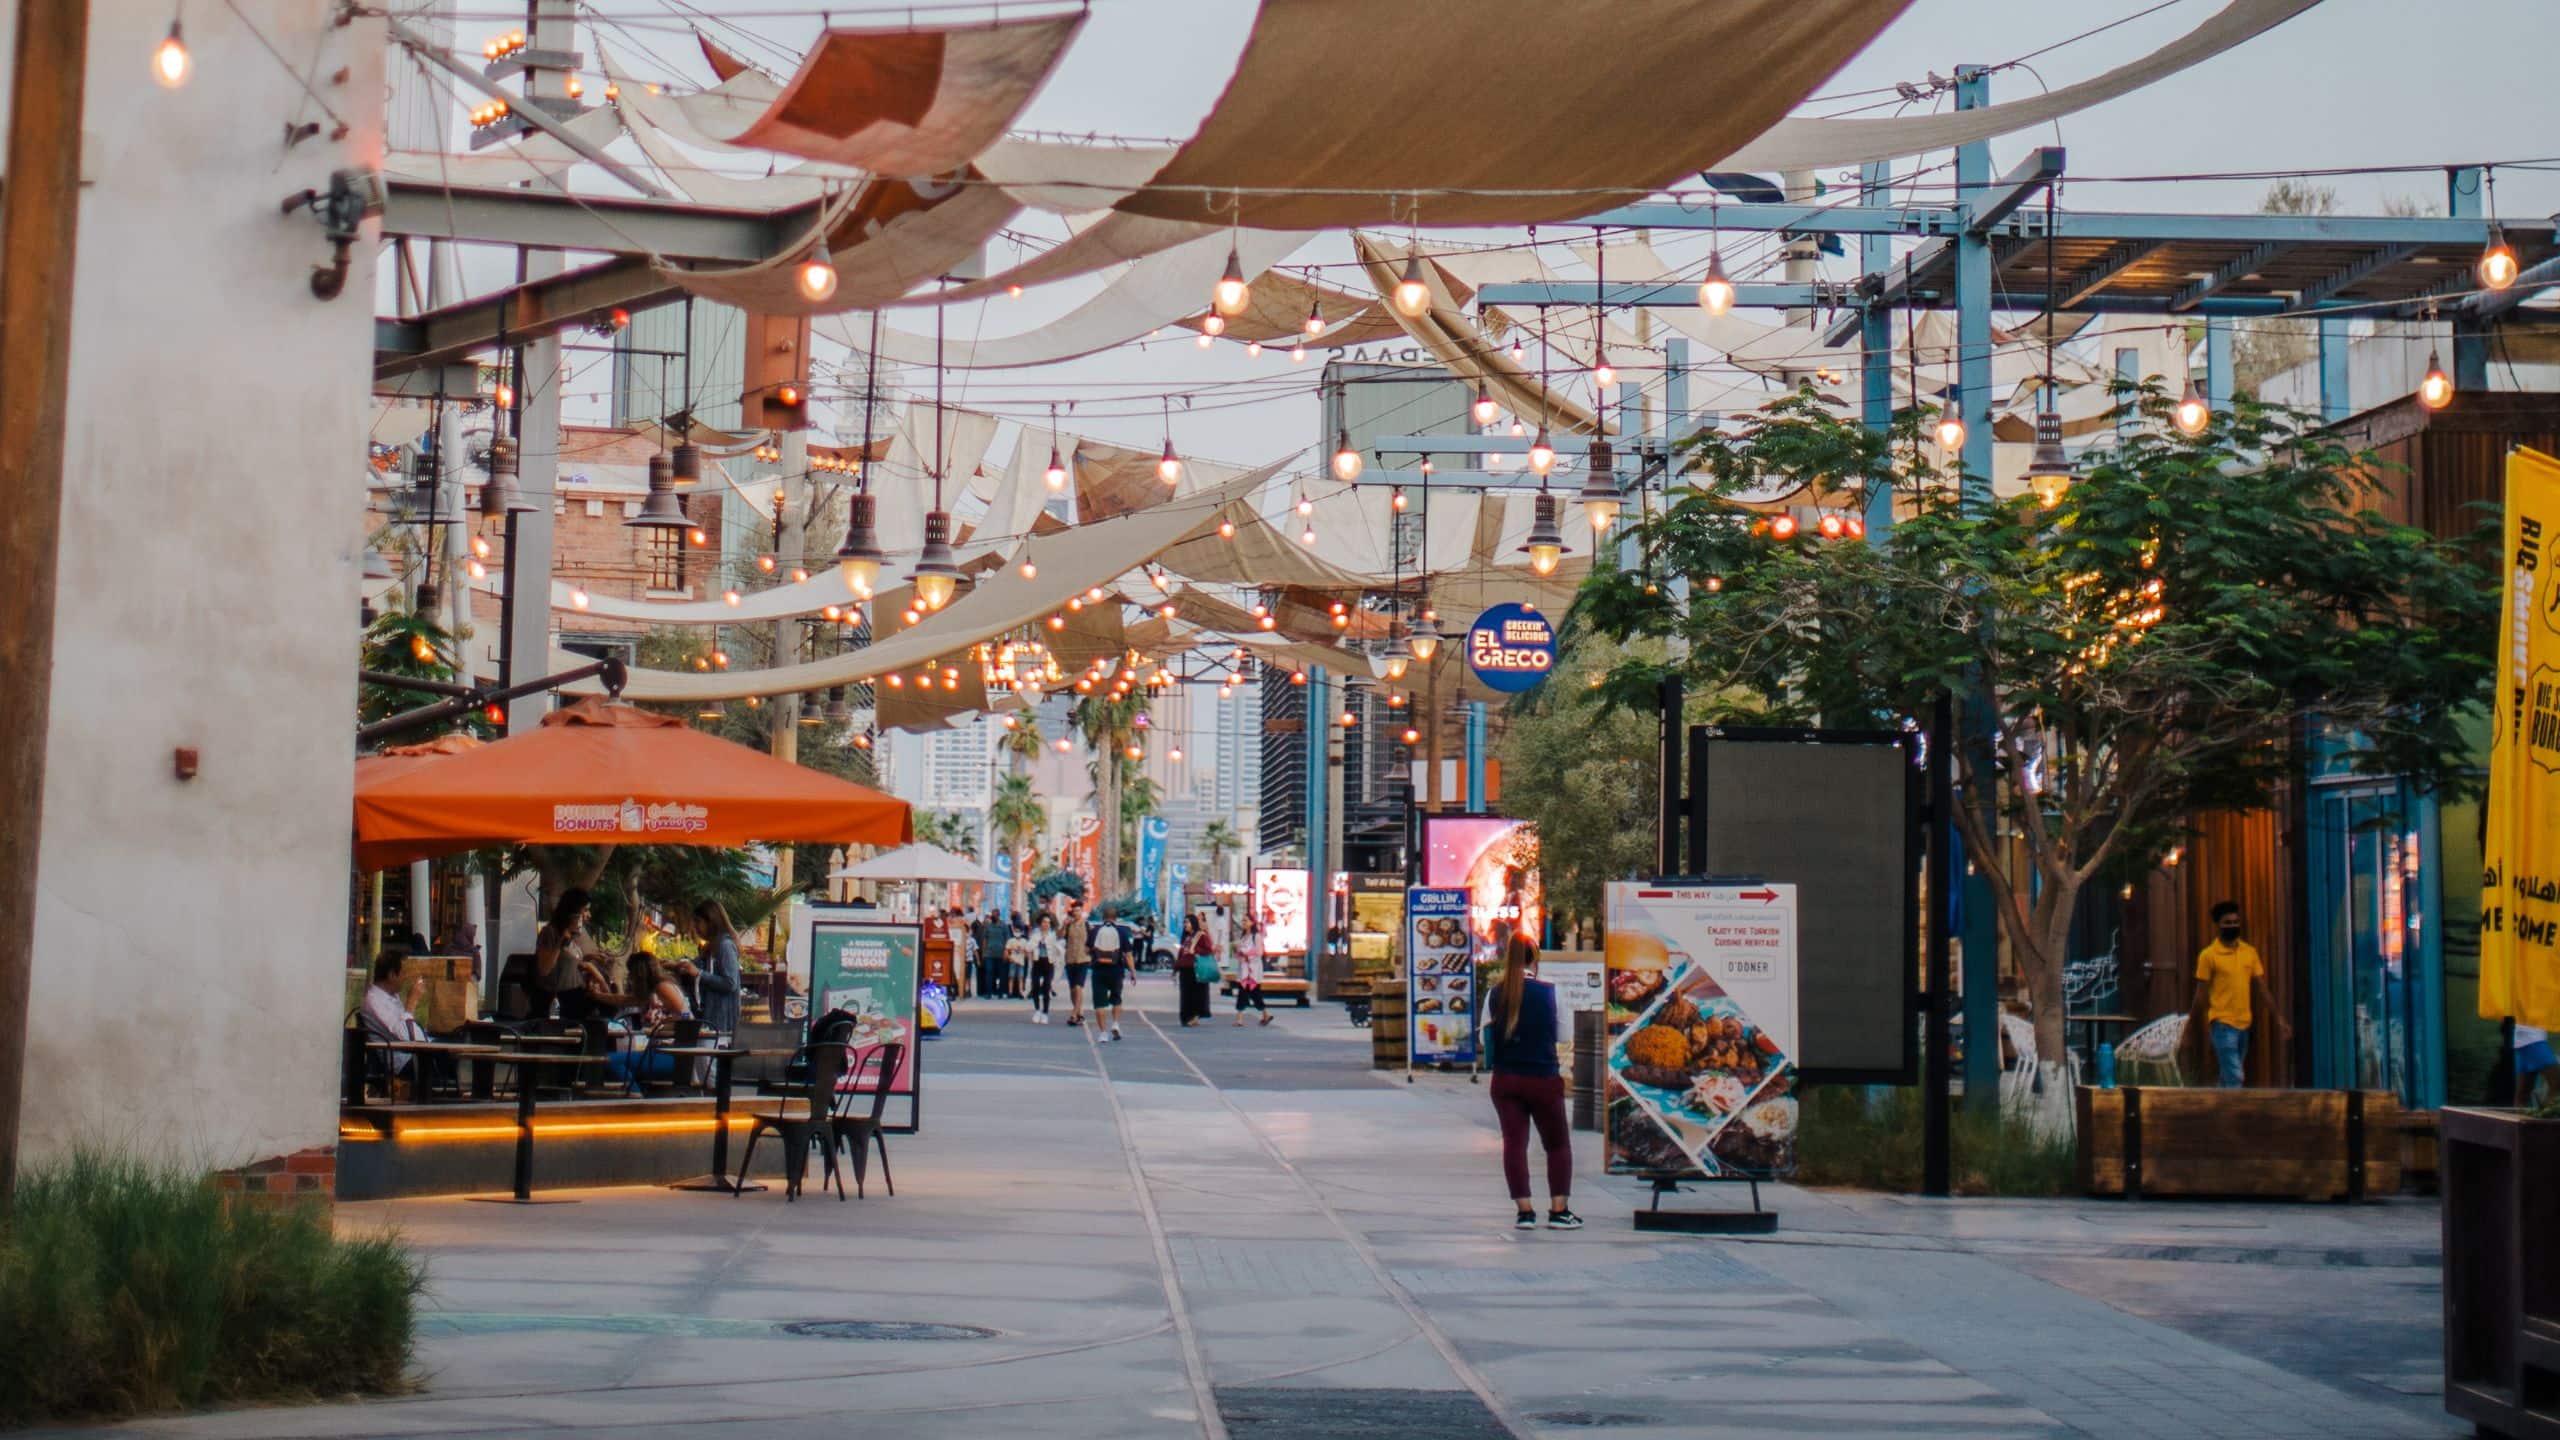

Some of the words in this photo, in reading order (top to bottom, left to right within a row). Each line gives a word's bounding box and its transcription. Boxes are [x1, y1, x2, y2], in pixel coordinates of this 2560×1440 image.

[1474, 629, 1500, 648] EL
[1504, 631, 1550, 642] DELICIOUS
[1474, 648, 1550, 668] GRECO
[555, 818, 616, 831] DONUTS
[1676, 890, 1693, 900] THIS
[1694, 890, 1711, 900] WAY
[1707, 926, 1732, 935] ENJOY
[1734, 927, 1747, 935] THE
[1750, 926, 1780, 935] TURKISH
[1714, 937, 1742, 947] CUISINE
[1744, 938, 1780, 947] HERITAGE
[840, 947, 891, 958] DUNKIN'
[840, 957, 889, 968] SEASON
